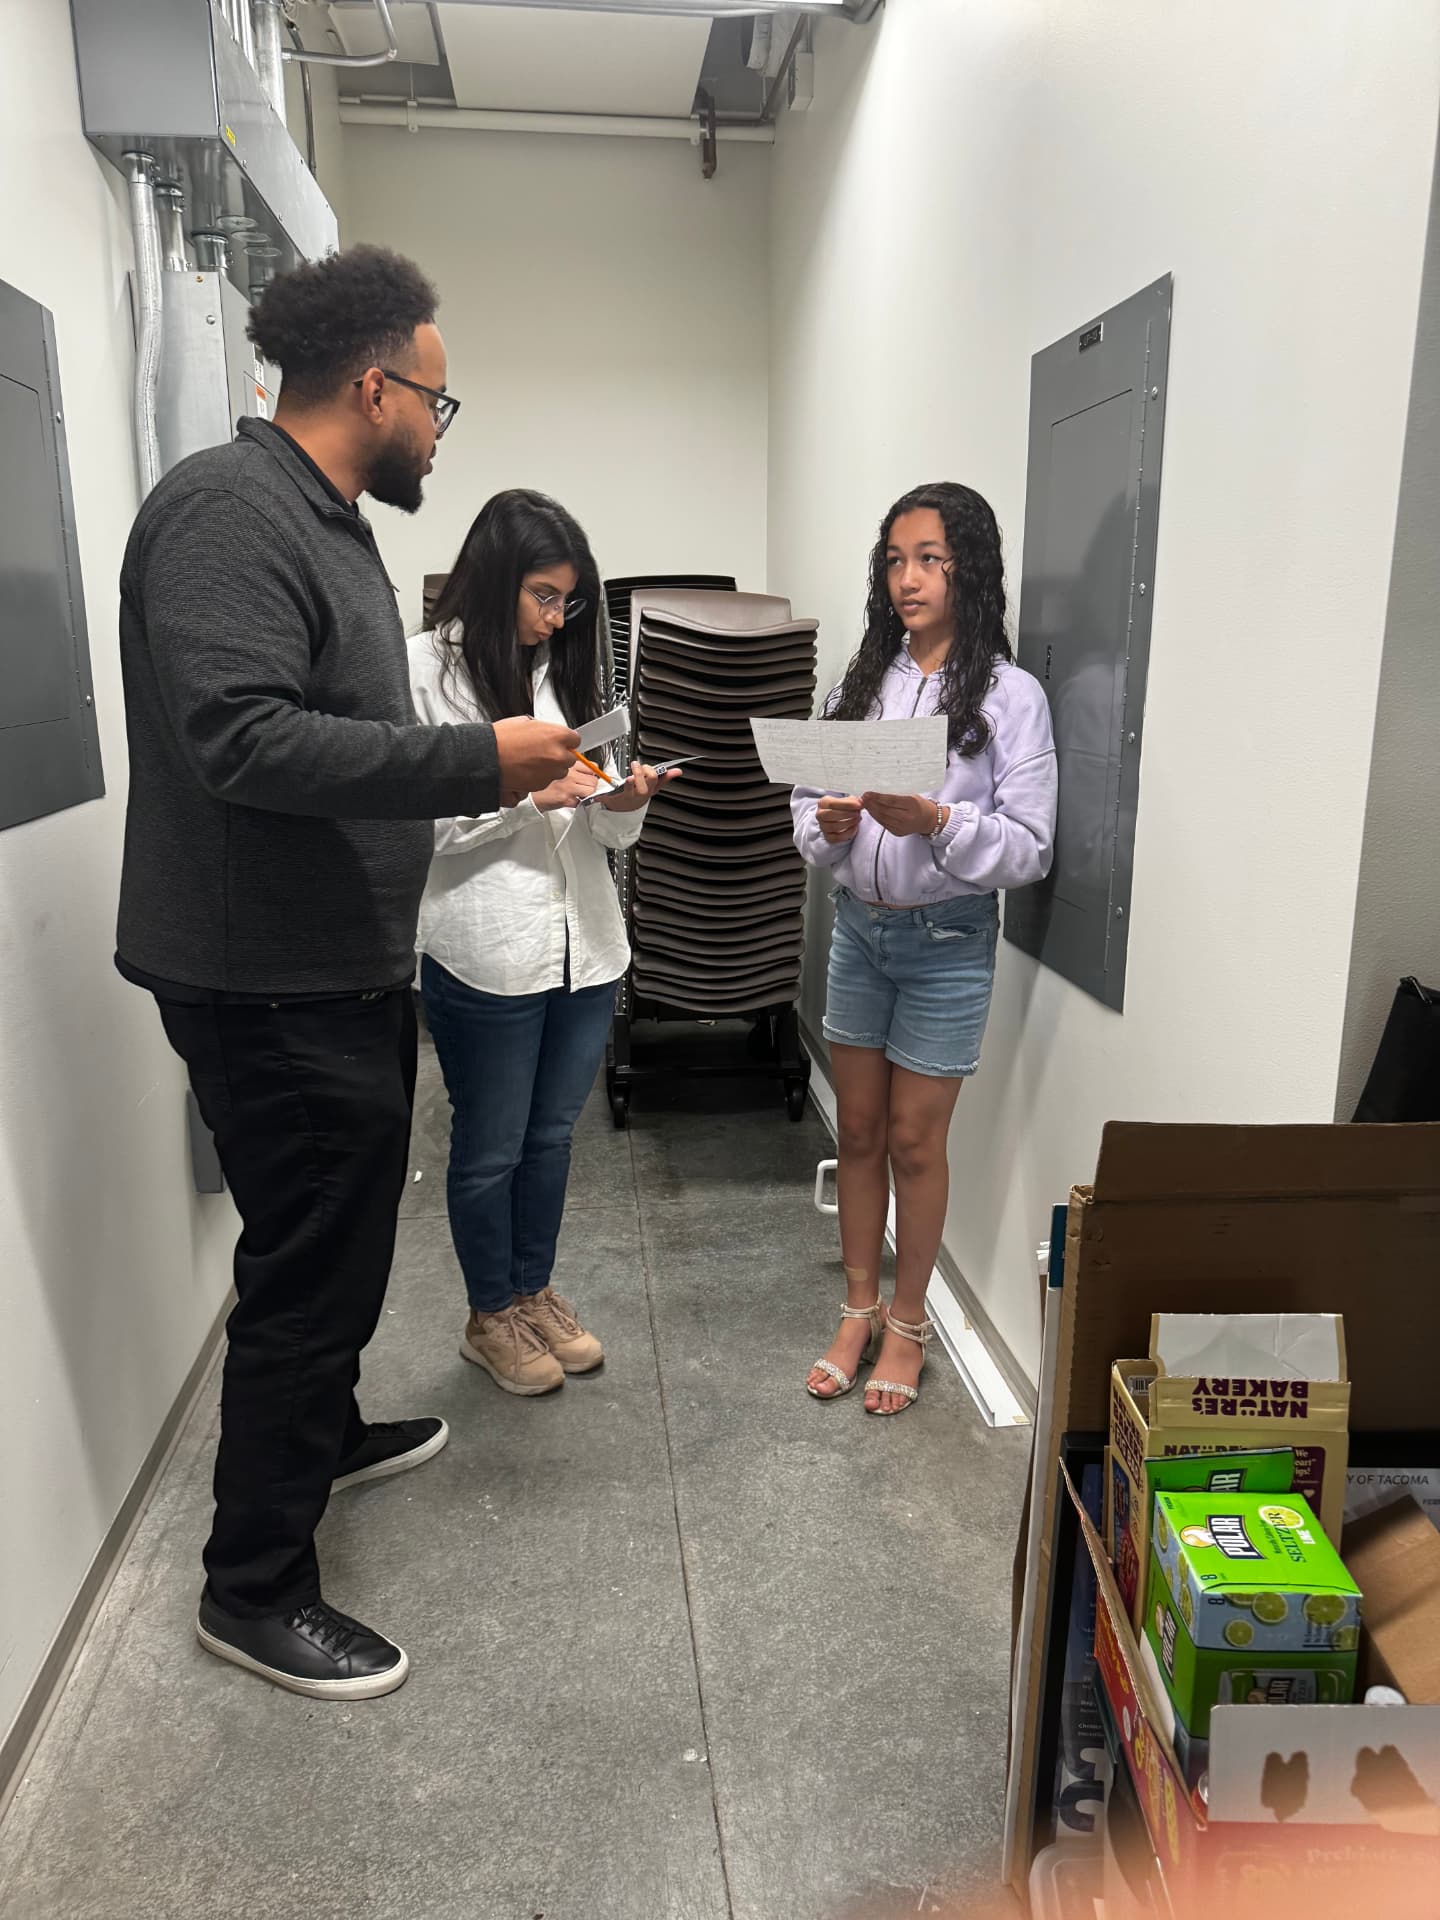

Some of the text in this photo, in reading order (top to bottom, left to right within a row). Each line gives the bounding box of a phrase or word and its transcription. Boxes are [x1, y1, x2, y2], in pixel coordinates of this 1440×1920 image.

[1191, 1377, 1309, 1398] BAKERY
[1356, 1474, 1375, 1485] OF
[1377, 1474, 1429, 1485] TACOMA
[1210, 1517, 1260, 1557] POLAR
[1268, 1511, 1307, 1563] SELTZER
